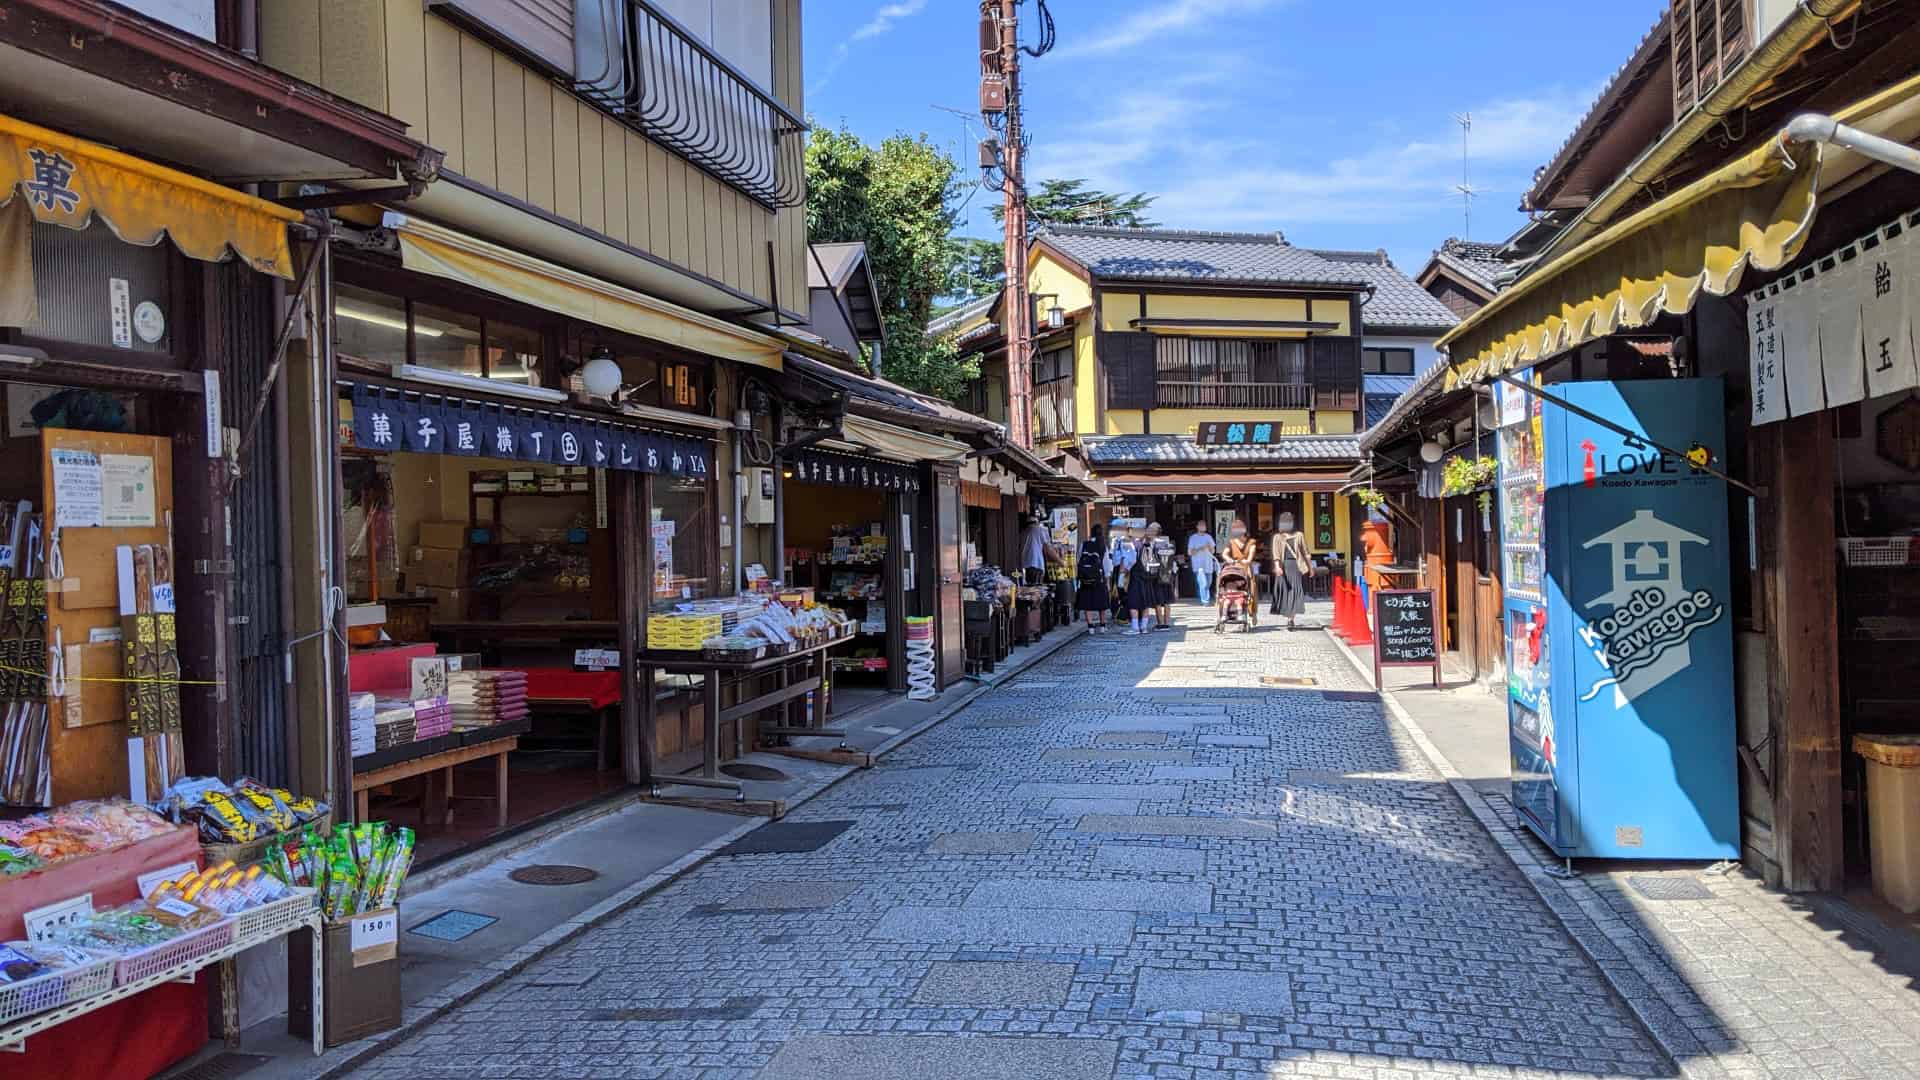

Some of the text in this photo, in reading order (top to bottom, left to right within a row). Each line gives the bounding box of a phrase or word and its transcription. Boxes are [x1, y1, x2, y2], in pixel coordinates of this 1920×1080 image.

[25, 149, 81, 214] 菓
[1601, 452, 1678, 475] LOVE
[1602, 477, 1678, 488] Koedo Kawagoe
[1578, 586, 1665, 648] Koedo
[1594, 589, 1712, 670] Kawagoe
